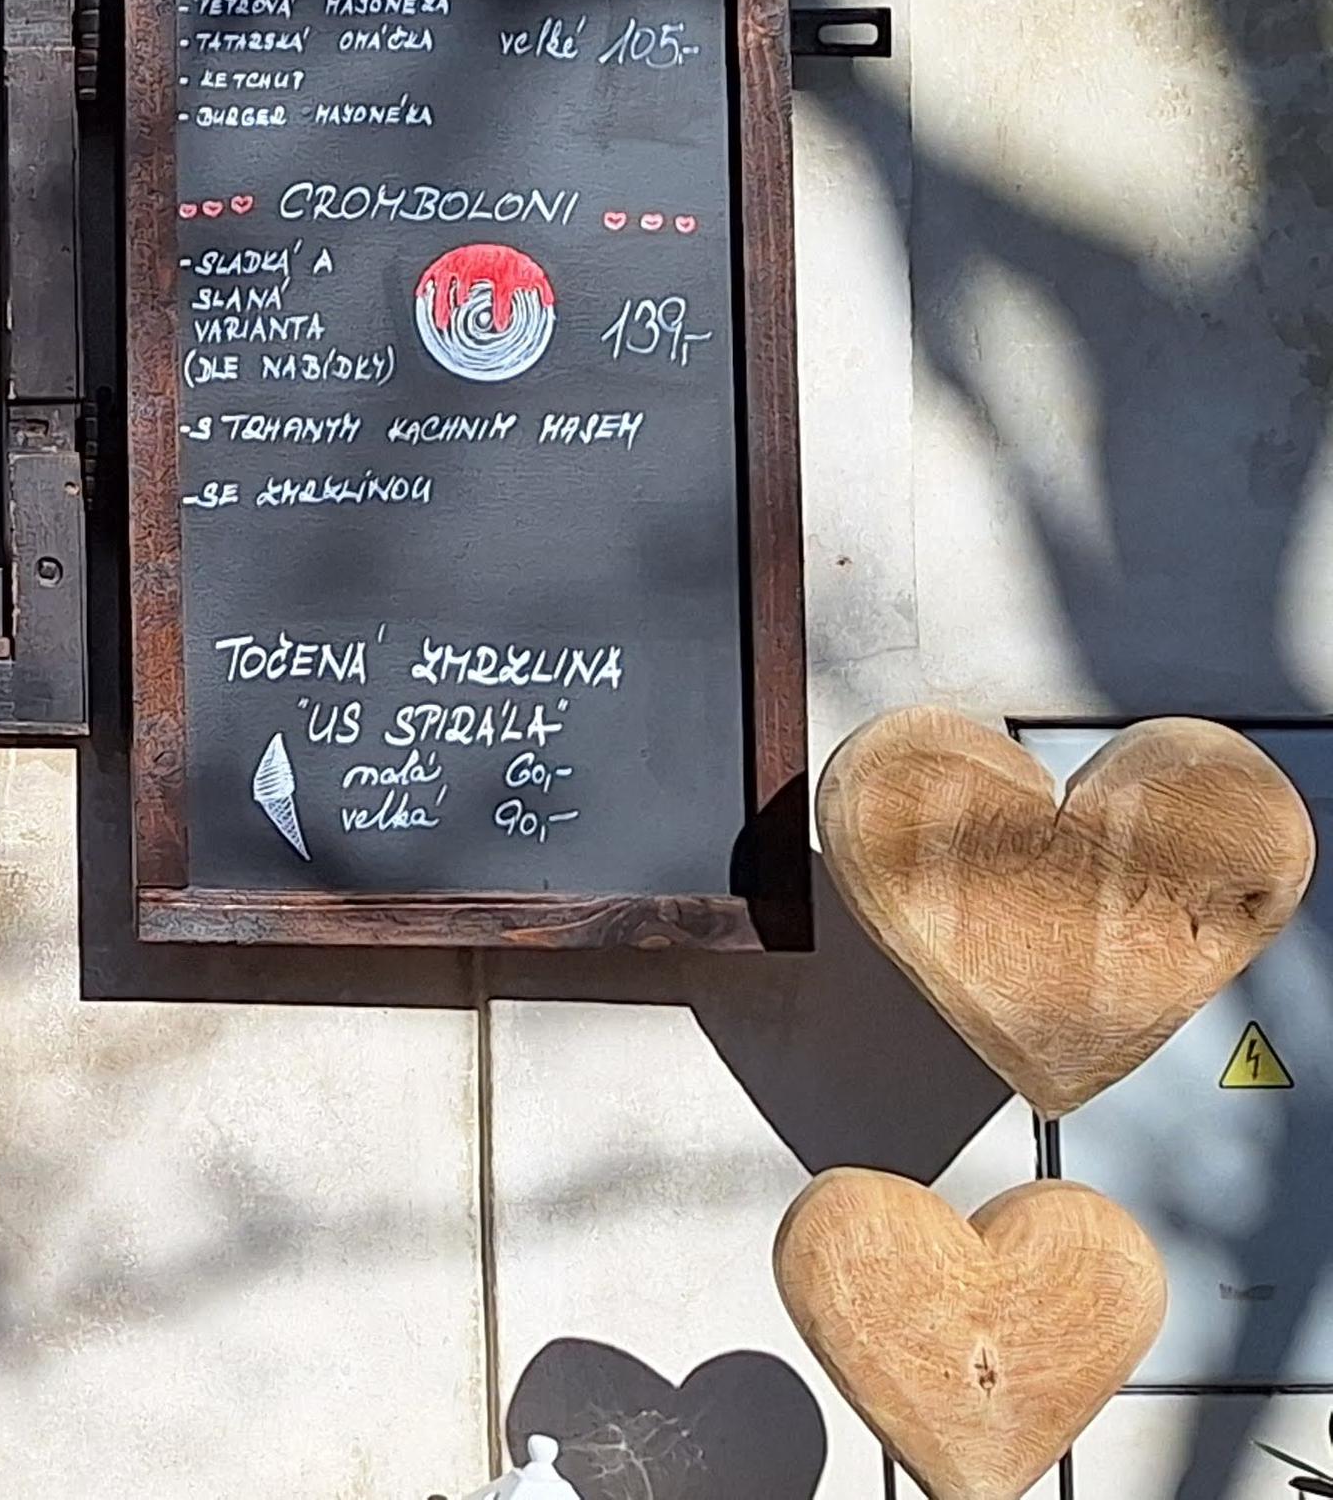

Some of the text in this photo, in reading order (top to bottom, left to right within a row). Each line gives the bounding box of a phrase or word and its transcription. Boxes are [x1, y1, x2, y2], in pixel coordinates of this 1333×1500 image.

[500, 15, 586, 59] velké
[280, 182, 579, 226] CROMBOLONI
[313, 248, 333, 274] A
[191, 275, 291, 313] SLANÁ
[194, 312, 326, 344] VARIANTA
[538, 411, 644, 451] MASEM
[215, 623, 385, 685] TOČENÁ
